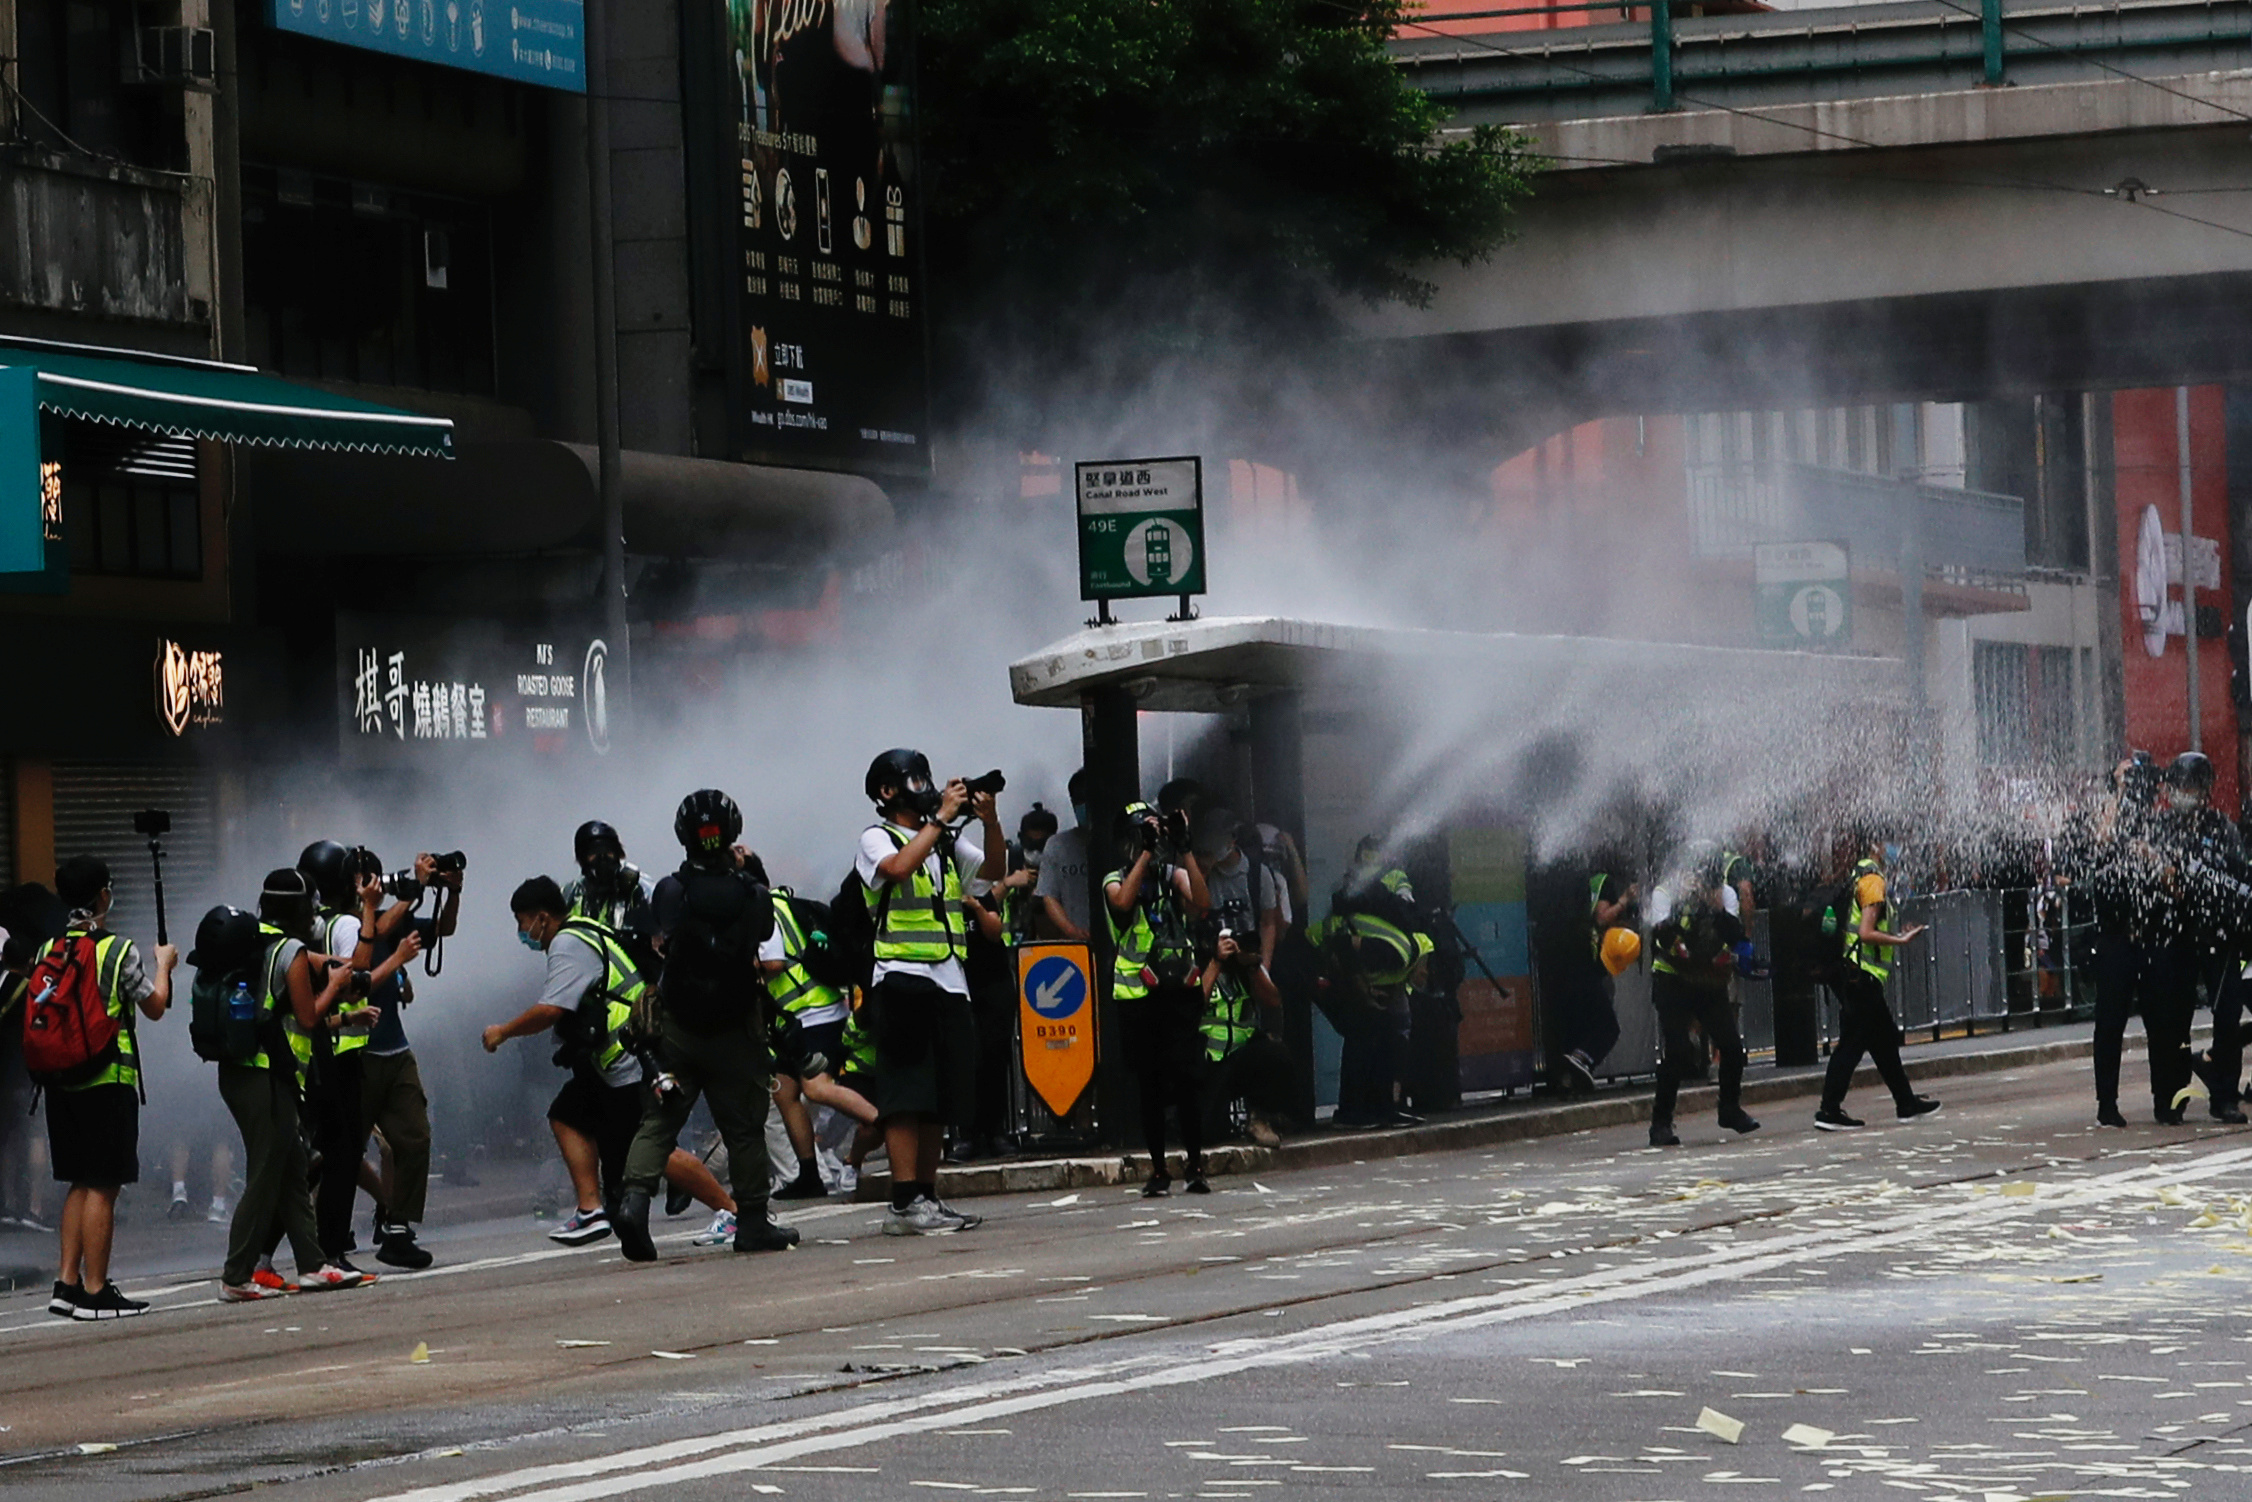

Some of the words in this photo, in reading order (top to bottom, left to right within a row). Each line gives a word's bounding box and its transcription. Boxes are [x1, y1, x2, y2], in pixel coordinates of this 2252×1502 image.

[1085, 469, 1151, 488] 堅拿道西
[40, 460, 63, 524] 蘭
[1085, 490, 1113, 500] Canal
[1115, 488, 1140, 498] Road
[1143, 487, 1169, 497] West
[1087, 518, 1118, 533] 49E
[517, 674, 549, 696] ROASTED
[550, 675, 575, 698] GOOSE
[525, 706, 569, 729] RESTAURANT
[2196, 863, 2239, 891] POLICE
[1036, 1024, 1077, 1037] B390
